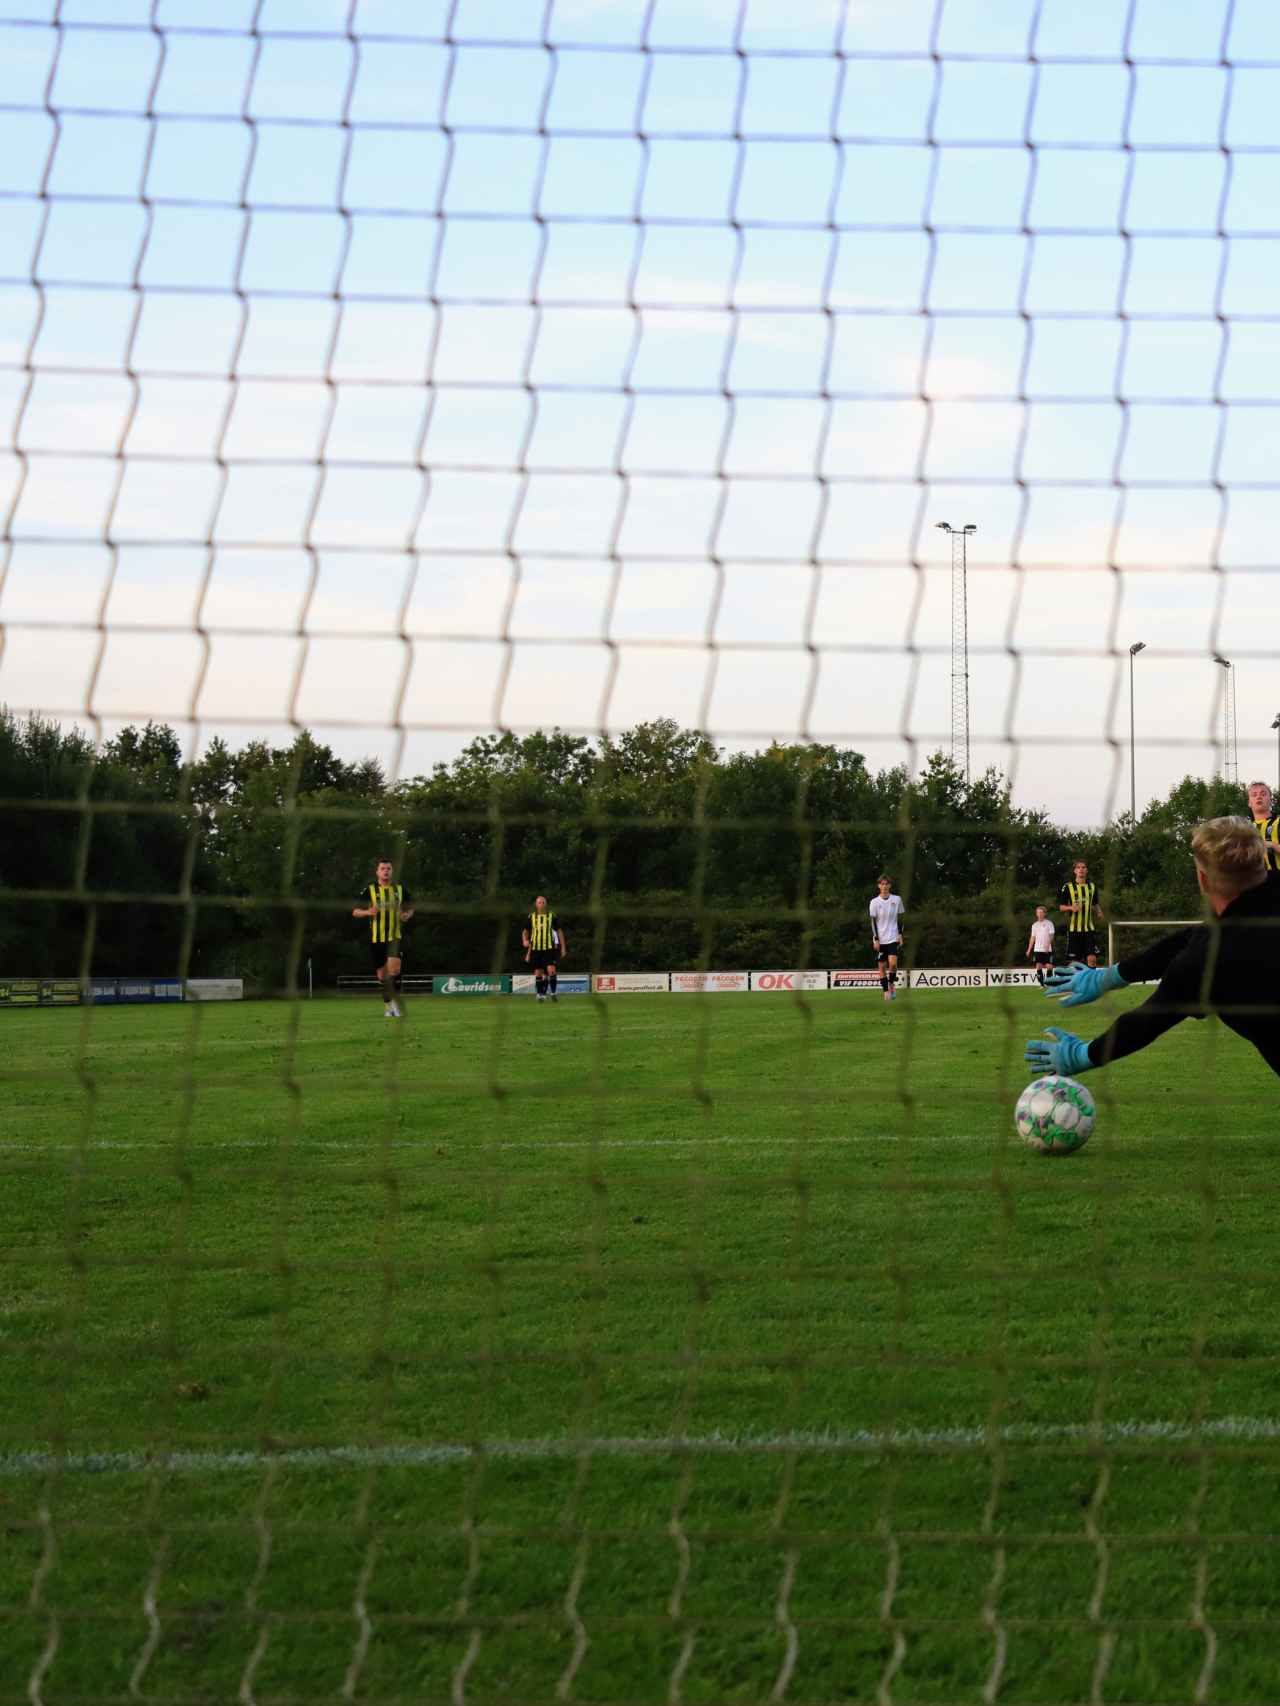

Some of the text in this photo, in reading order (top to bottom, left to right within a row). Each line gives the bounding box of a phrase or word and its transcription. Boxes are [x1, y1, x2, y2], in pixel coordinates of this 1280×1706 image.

[441, 977, 501, 993] Lauridsen
[757, 975, 794, 989] OK
[915, 972, 981, 986] Acronis
